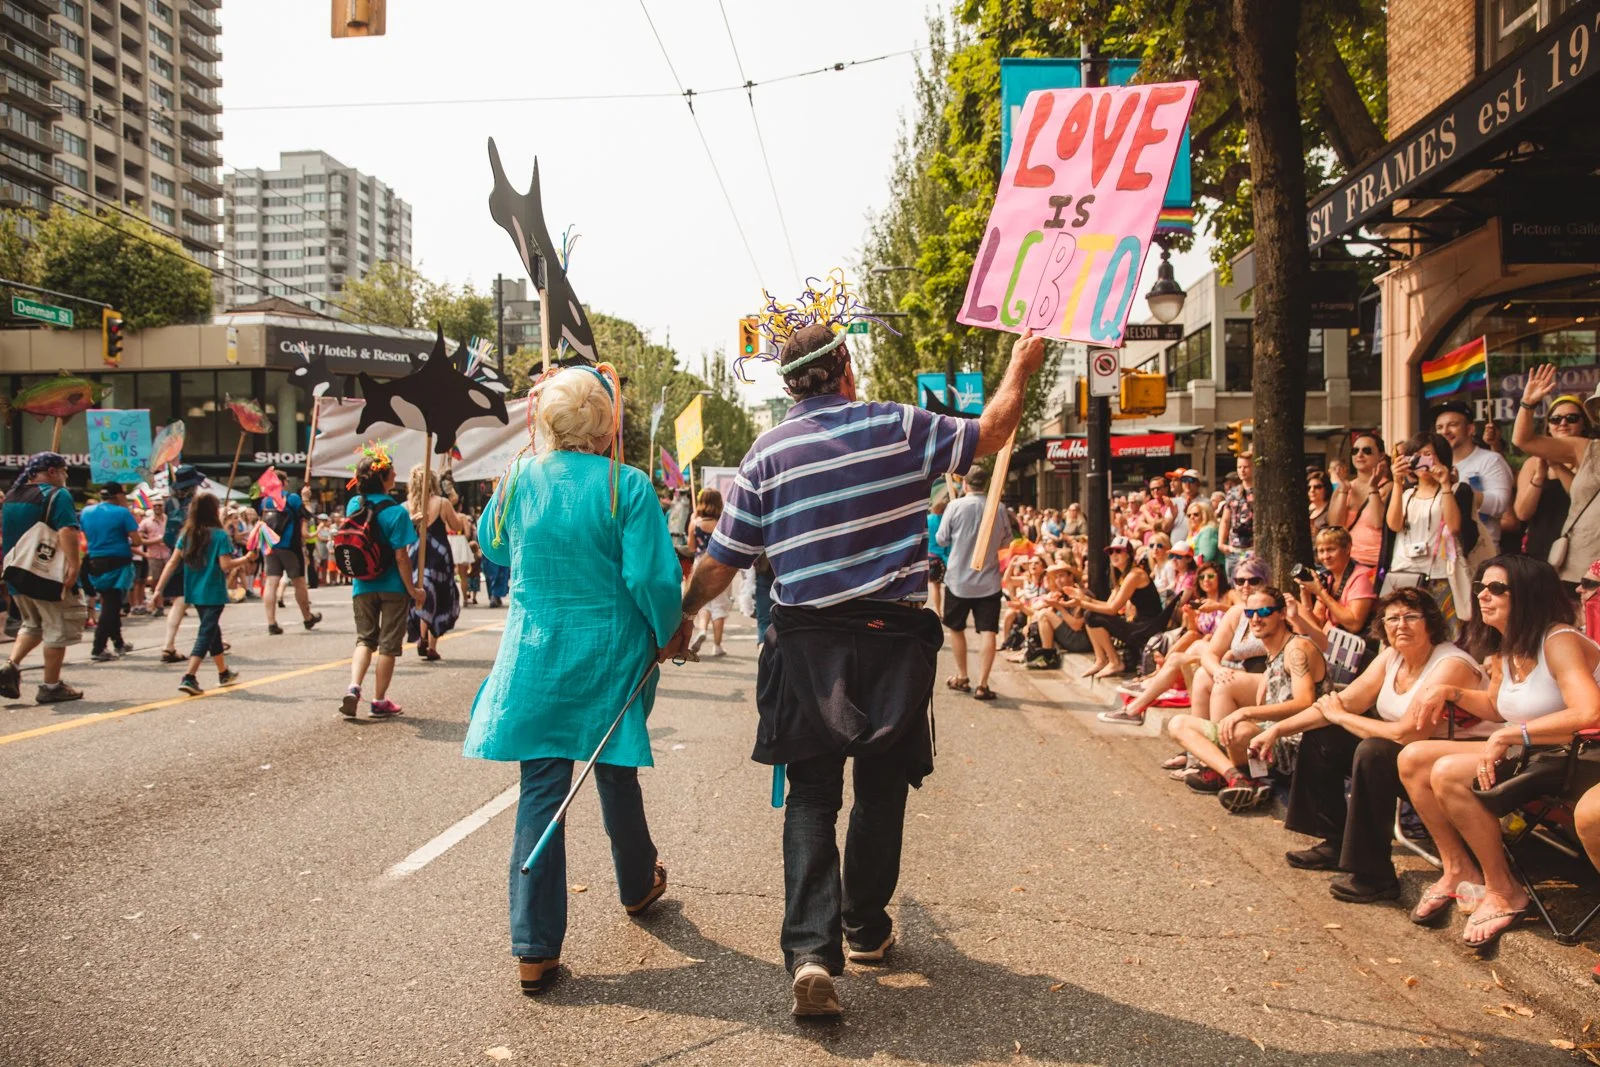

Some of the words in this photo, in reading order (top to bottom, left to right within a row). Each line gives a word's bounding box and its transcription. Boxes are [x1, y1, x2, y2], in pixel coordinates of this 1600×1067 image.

[1308, 201, 1334, 245] ST
[1344, 114, 1457, 224] FRAMES
[1477, 68, 1527, 135] est
[1547, 12, 1600, 93] 19
[1013, 86, 1187, 191] LOVE
[1044, 194, 1095, 229] IS
[1512, 222, 1561, 236] Picture
[965, 227, 1142, 341] LGBTQ
[17, 301, 56, 320] Denman
[59, 311, 70, 323] St
[280, 340, 316, 355] Cot
[360, 348, 371, 359] &
[1502, 368, 1600, 391] CUTOM
[94, 416, 112, 428] WE
[100, 429, 139, 442] LOVE
[107, 444, 138, 457] THIS
[1046, 441, 1068, 459] Tim
[1118, 446, 1146, 456] COFFEE
[102, 458, 148, 470] COAST
[343, 549, 355, 576] SPORT
